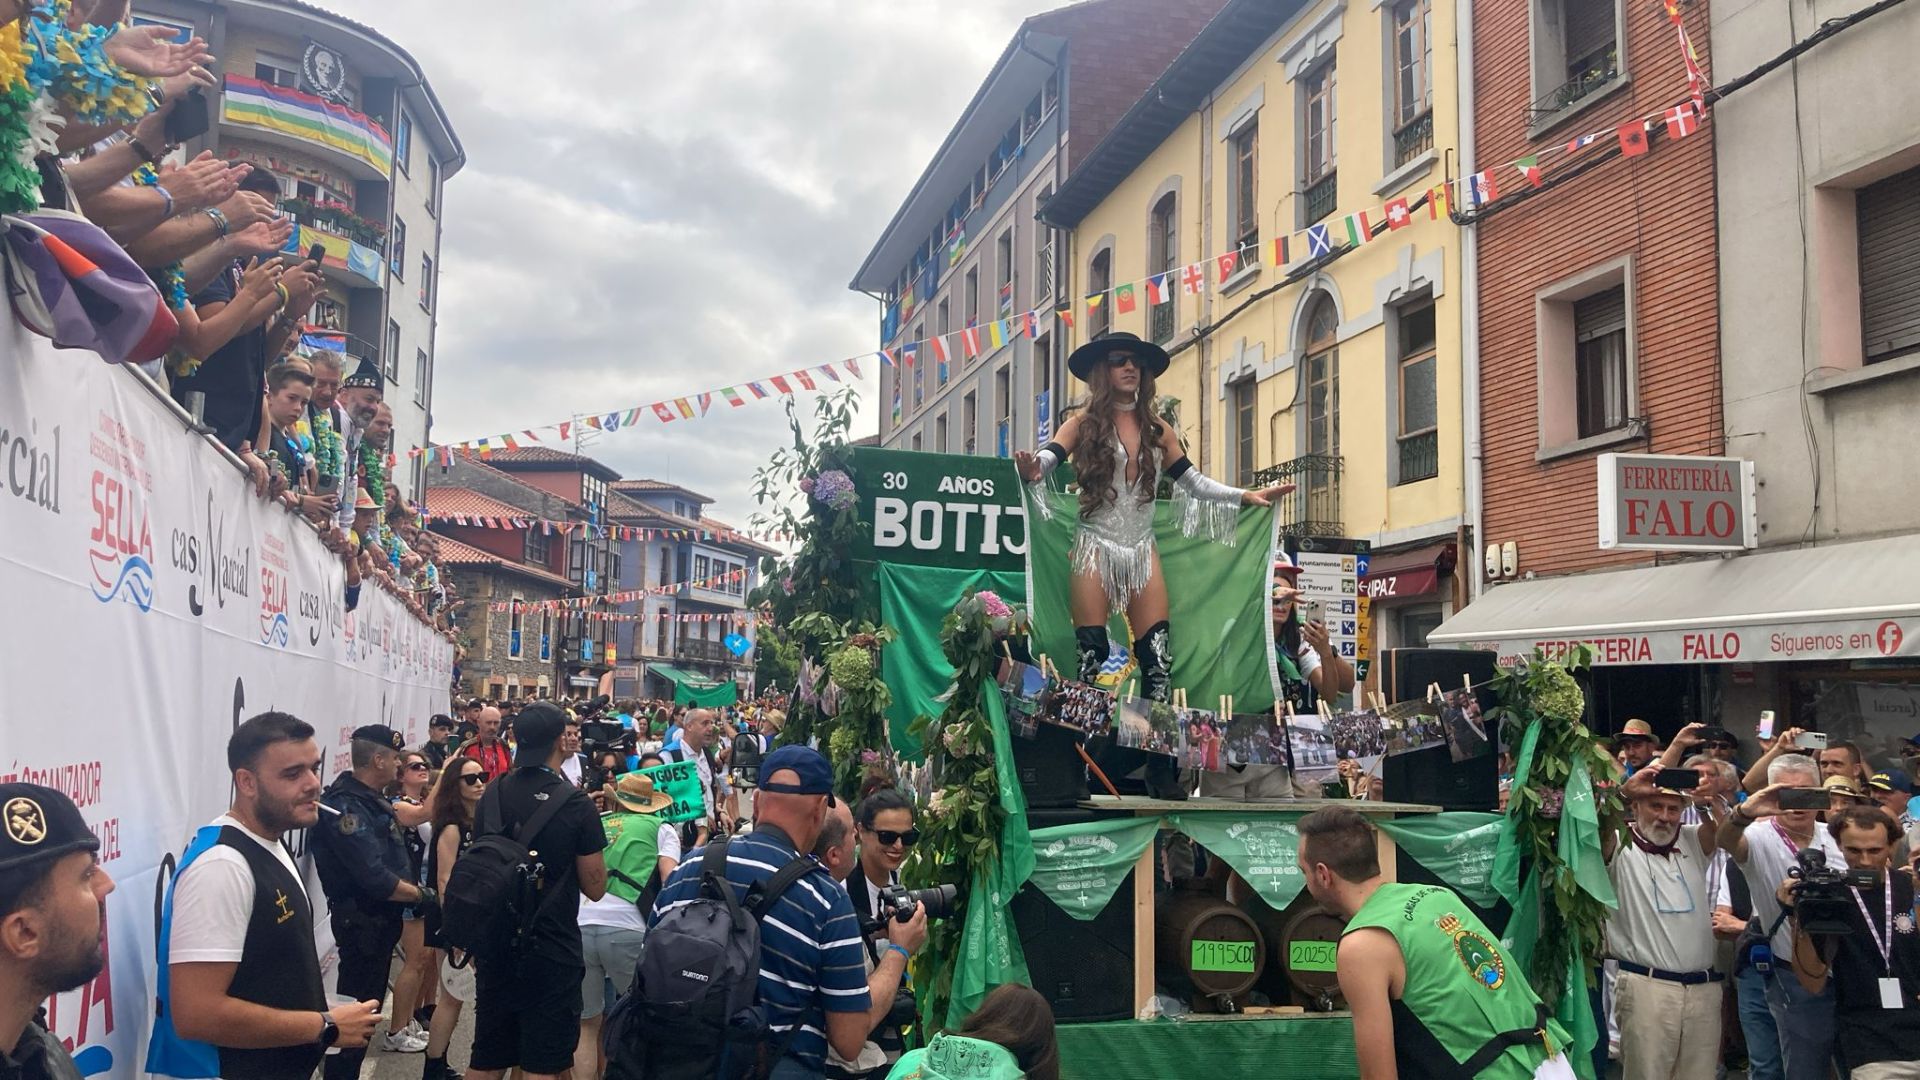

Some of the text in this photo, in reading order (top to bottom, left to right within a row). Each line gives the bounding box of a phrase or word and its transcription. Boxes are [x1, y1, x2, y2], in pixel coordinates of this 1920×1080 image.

[882, 471, 995, 497] 30 AÑOS
[1623, 463, 1734, 493] FERRETERÍA
[91, 469, 154, 564] SELLA
[1624, 499, 1736, 538] FALO
[189, 487, 250, 617] Marcial
[261, 567, 288, 617] SELLA
[1308, 584, 1333, 592] Peruyal
[300, 590, 320, 621] casa
[1683, 632, 1741, 660] FALO
[1771, 632, 1844, 656] Síguenos
[1849, 633, 1872, 650] en
[103, 817, 121, 863] DEL
